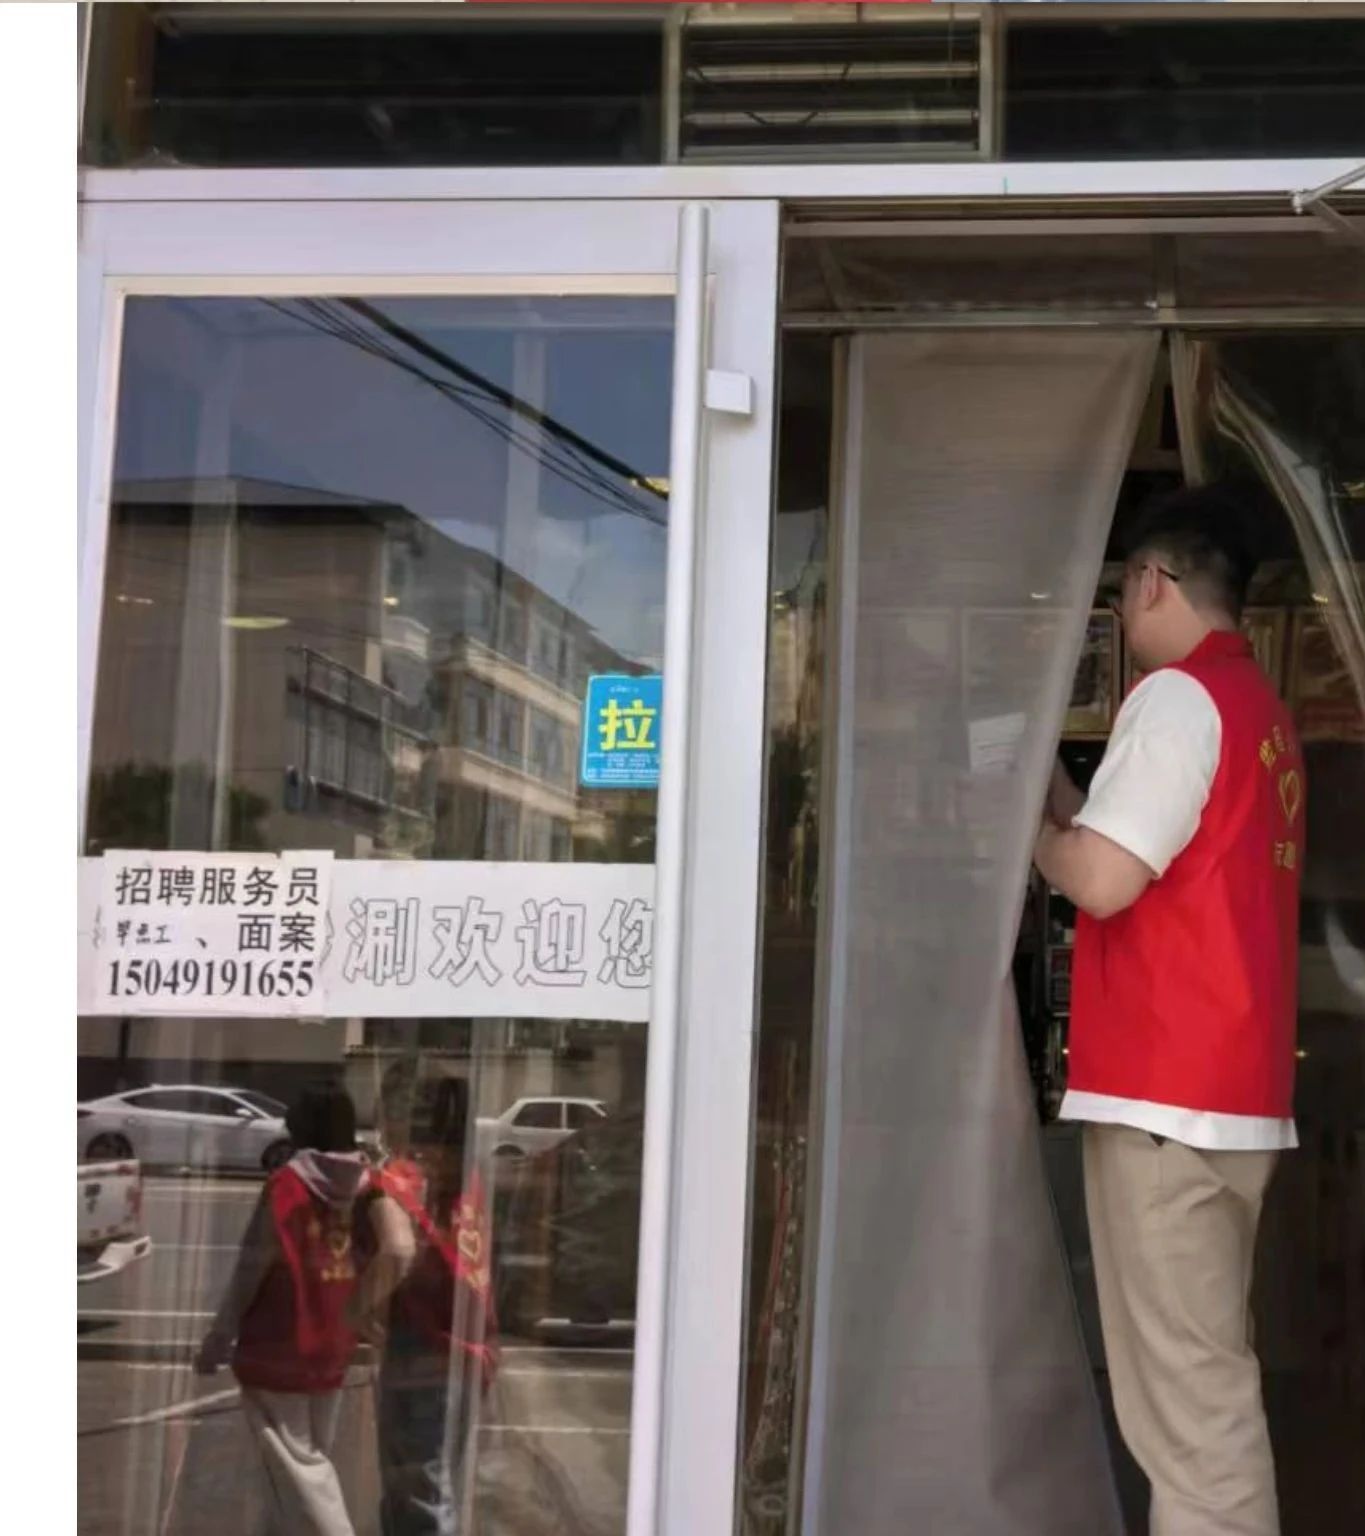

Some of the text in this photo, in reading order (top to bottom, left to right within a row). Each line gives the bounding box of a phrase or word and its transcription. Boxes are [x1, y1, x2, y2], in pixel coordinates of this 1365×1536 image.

[597, 697, 657, 752] 拉
[115, 865, 321, 907] 招聘服务员
[108, 958, 314, 997] 15049191655
